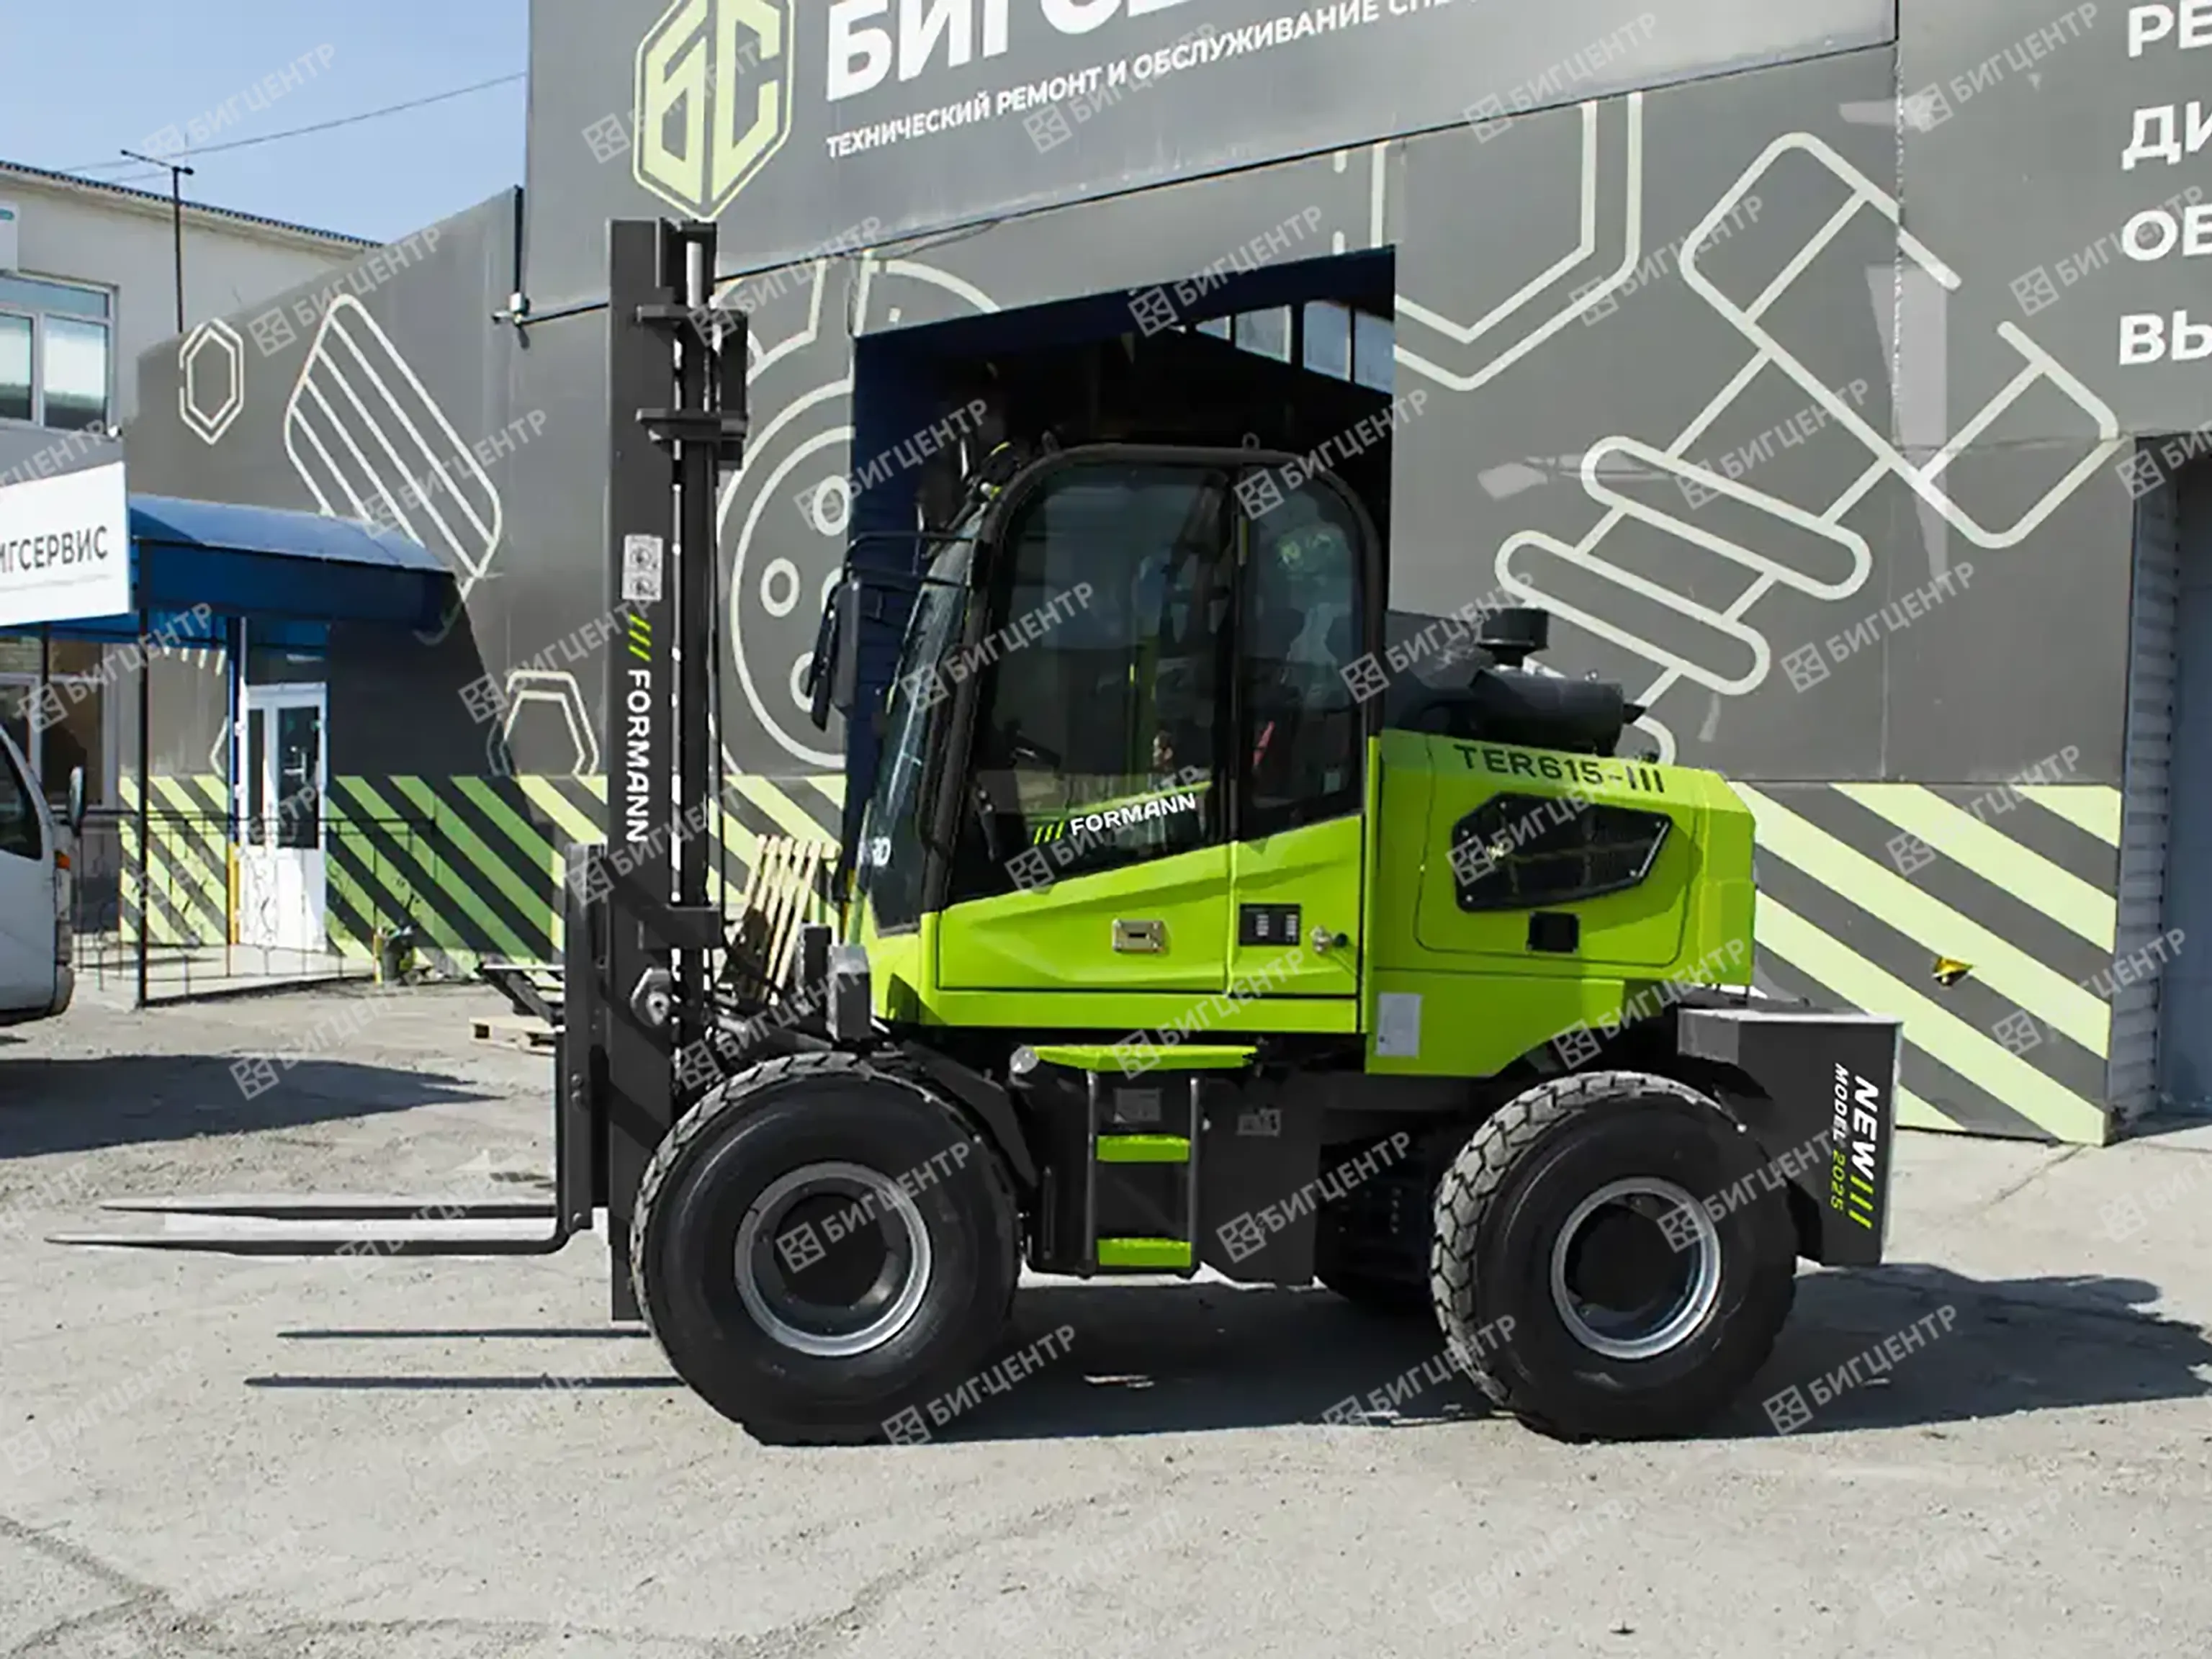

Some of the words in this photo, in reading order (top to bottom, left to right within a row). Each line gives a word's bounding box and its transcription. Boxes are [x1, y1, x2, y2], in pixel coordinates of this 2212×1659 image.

[825, 89, 992, 158] ТЕХНИЧЕСКИЙ
[996, 66, 1103, 116] РЕМОНТ
[1107, 60, 1127, 87] И
[1132, 0, 1380, 79] ОБСЛУЖИВАНИЕ
[626, 669, 652, 843] FORMANN
[1452, 743, 1664, 793] TER615-III
[1069, 792, 1196, 837] FORMANN
[1833, 1062, 1849, 1141] MODEL
[1851, 1074, 1879, 1182] NEW
[1830, 1148, 1846, 1210] 2025
